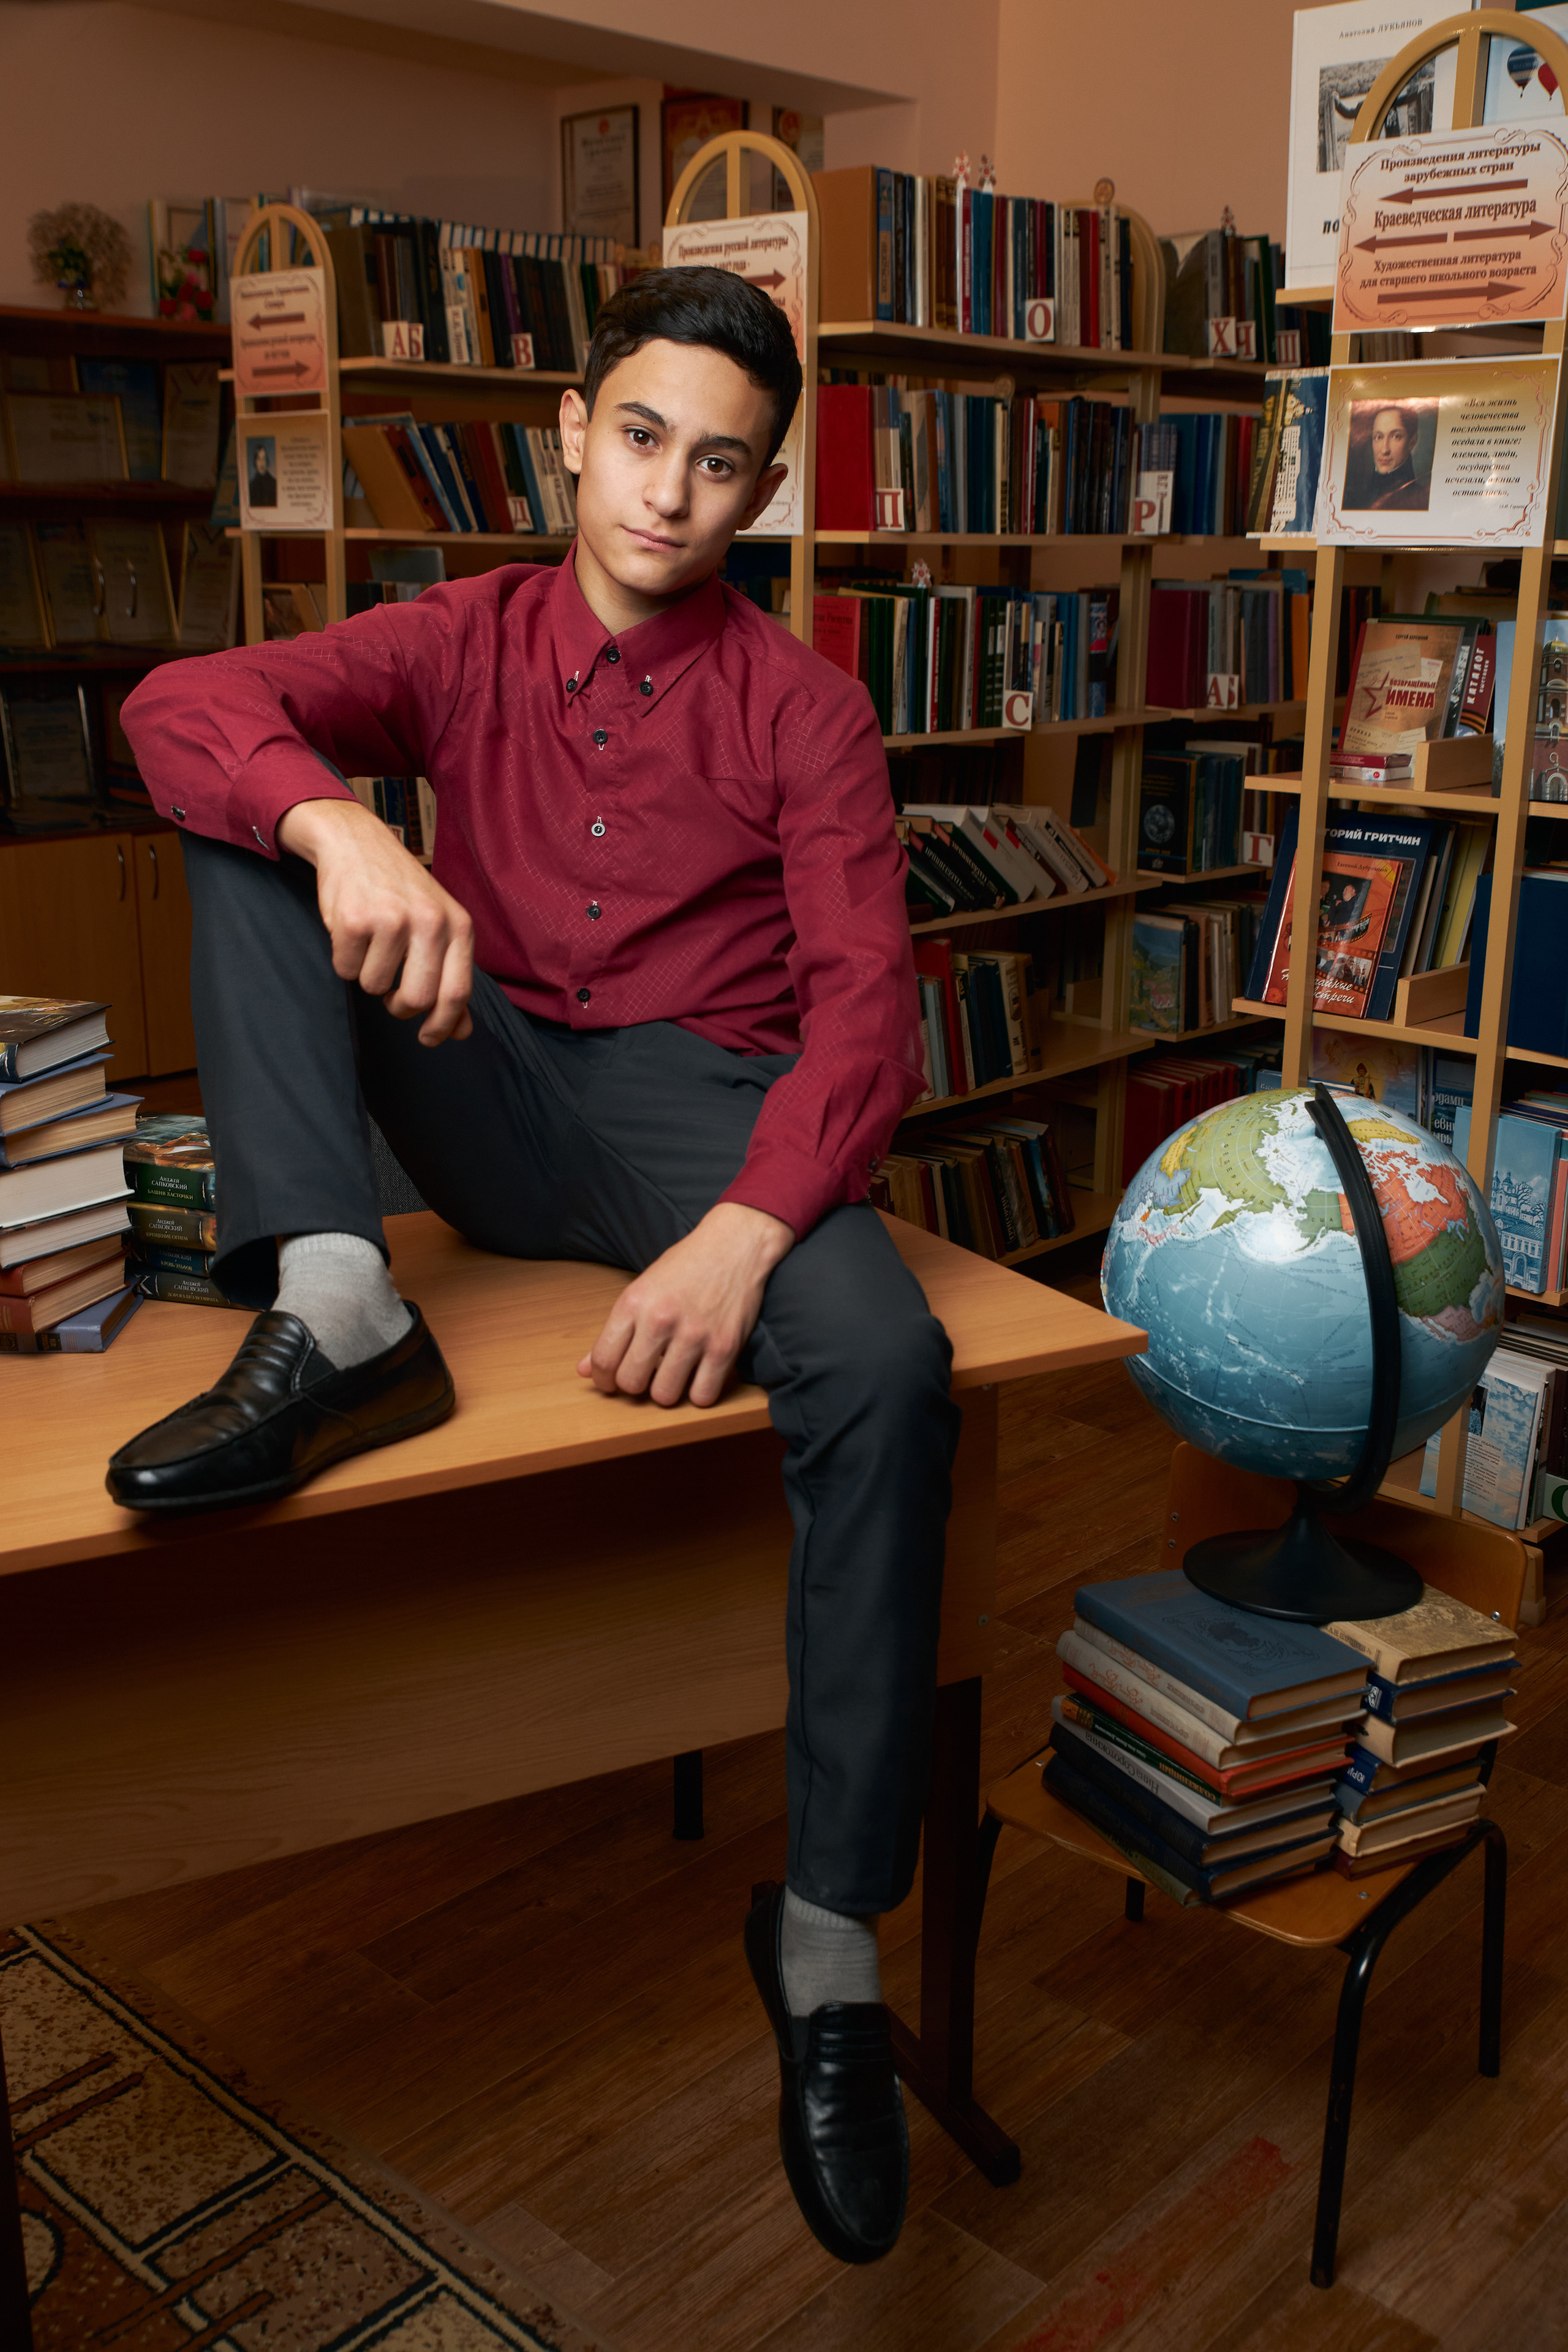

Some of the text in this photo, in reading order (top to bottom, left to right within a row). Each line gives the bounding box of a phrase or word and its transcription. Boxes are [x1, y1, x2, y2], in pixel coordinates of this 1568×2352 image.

[1380, 142, 1540, 172] Произведения литературы
[1404, 162, 1514, 184] зарубежных стран
[1374, 199, 1536, 232] Краеведческая литература
[1374, 250, 1521, 273] Художественная литература
[1360, 266, 1536, 290] для старшего школьного возраста
[1028, 303, 1051, 338] О
[393, 326, 407, 356] А
[409, 328, 420, 356] Б
[1212, 322, 1231, 354] Х
[1237, 325, 1252, 355] Ч
[514, 339, 532, 366] В
[1461, 412, 1519, 421] человечества
[1487, 399, 1517, 407] жизнь
[1450, 424, 1526, 434] последовательно
[1452, 437, 1485, 446] оседала
[1452, 450, 1518, 459] племена, люди,
[513, 500, 530, 529] Д
[877, 492, 903, 527] П
[1134, 501, 1155, 532] Р
[1208, 677, 1223, 706] А
[1385, 689, 1435, 709] ИМЕНА
[1006, 695, 1029, 725] С
[1250, 835, 1272, 863] Г
[1325, 828, 1421, 846] ГОРИЙ ГРИТЧИН
[151, 1180, 187, 1190] САПКОВСКИЙ
[167, 1191, 193, 1200] ЛАСТОЧКИ
[149, 1223, 183, 1232] САПКОВСКИЙ
[1085, 1732, 1135, 1776] Соротокина
[1136, 1770, 1159, 1795] Нина
[1159, 1762, 1216, 1802] СОЛЖЕНИЦЫН
